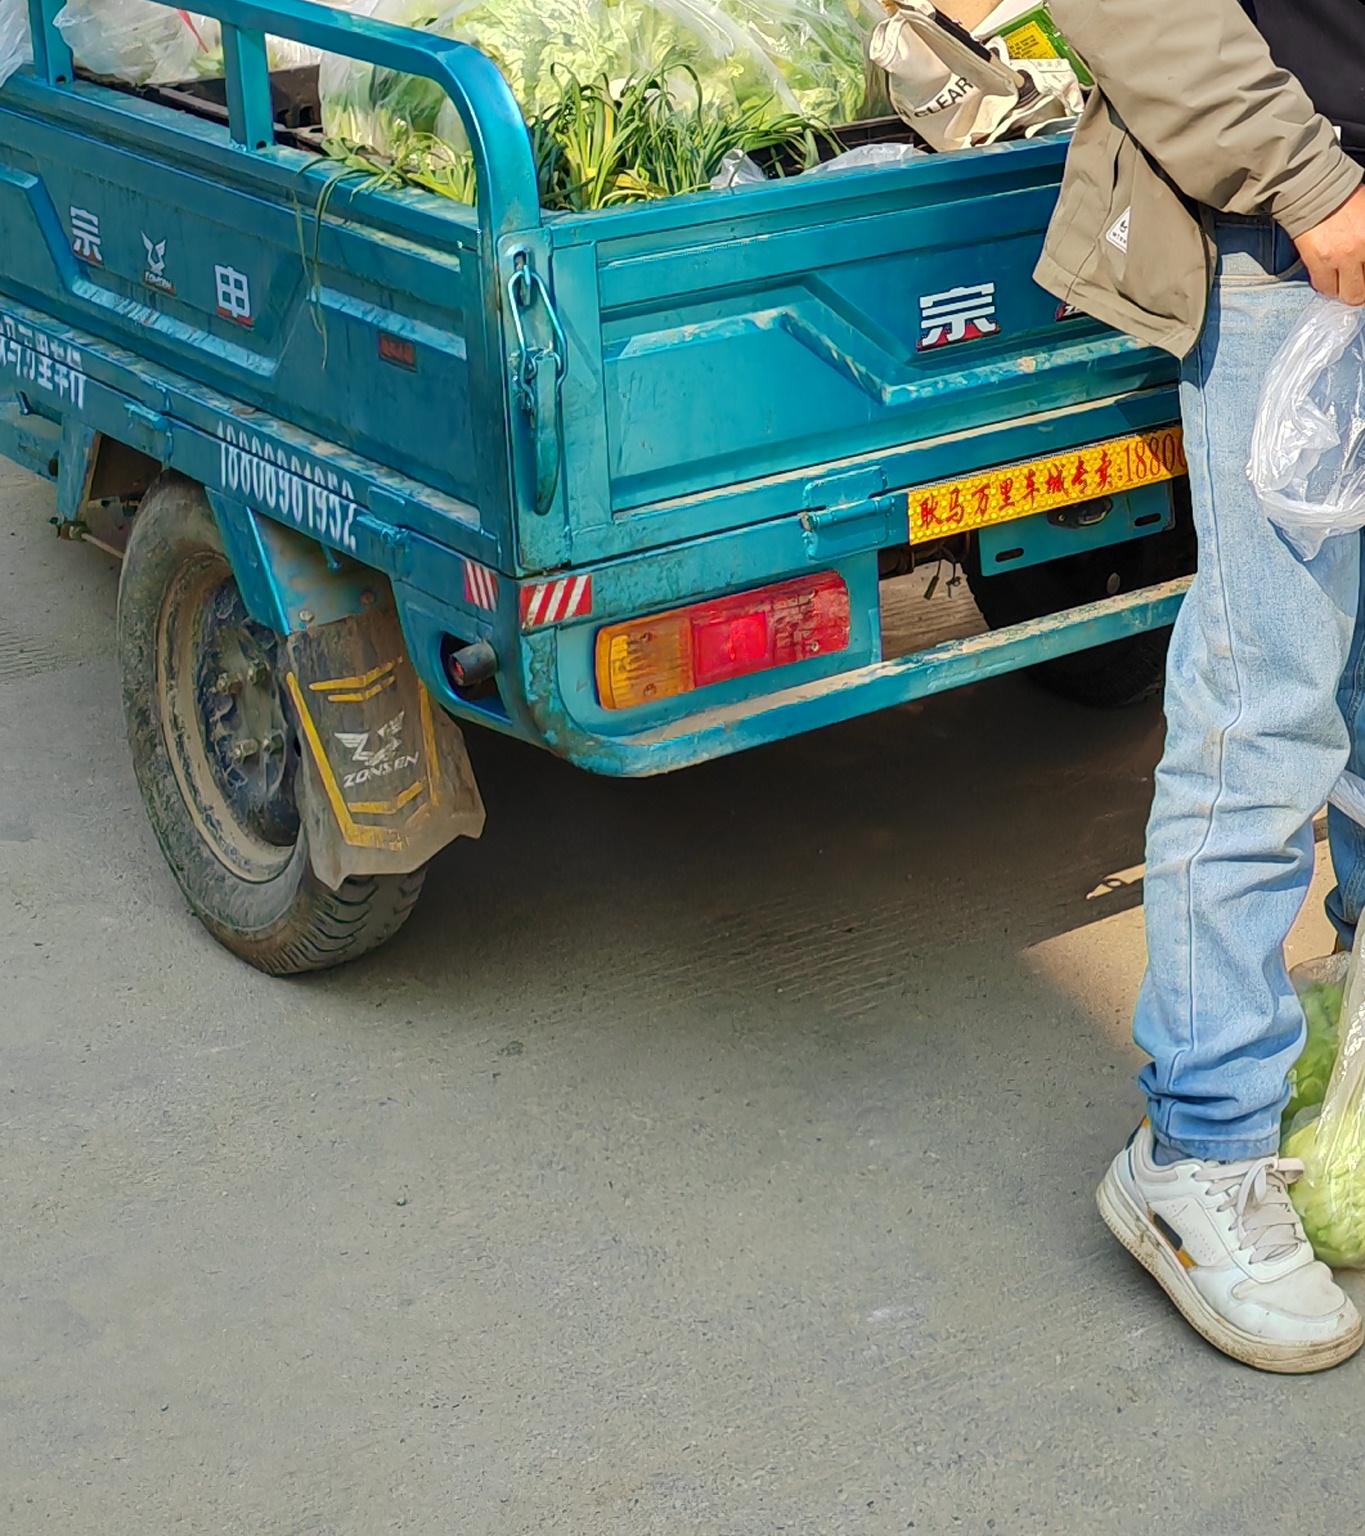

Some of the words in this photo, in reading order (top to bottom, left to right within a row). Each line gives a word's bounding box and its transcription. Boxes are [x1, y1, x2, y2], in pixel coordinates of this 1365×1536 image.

[914, 76, 975, 118] CLEAR
[70, 205, 103, 261] 宗
[213, 264, 251, 319] 申
[919, 282, 996, 347] 宗
[343, 751, 419, 789] ZONSEN
